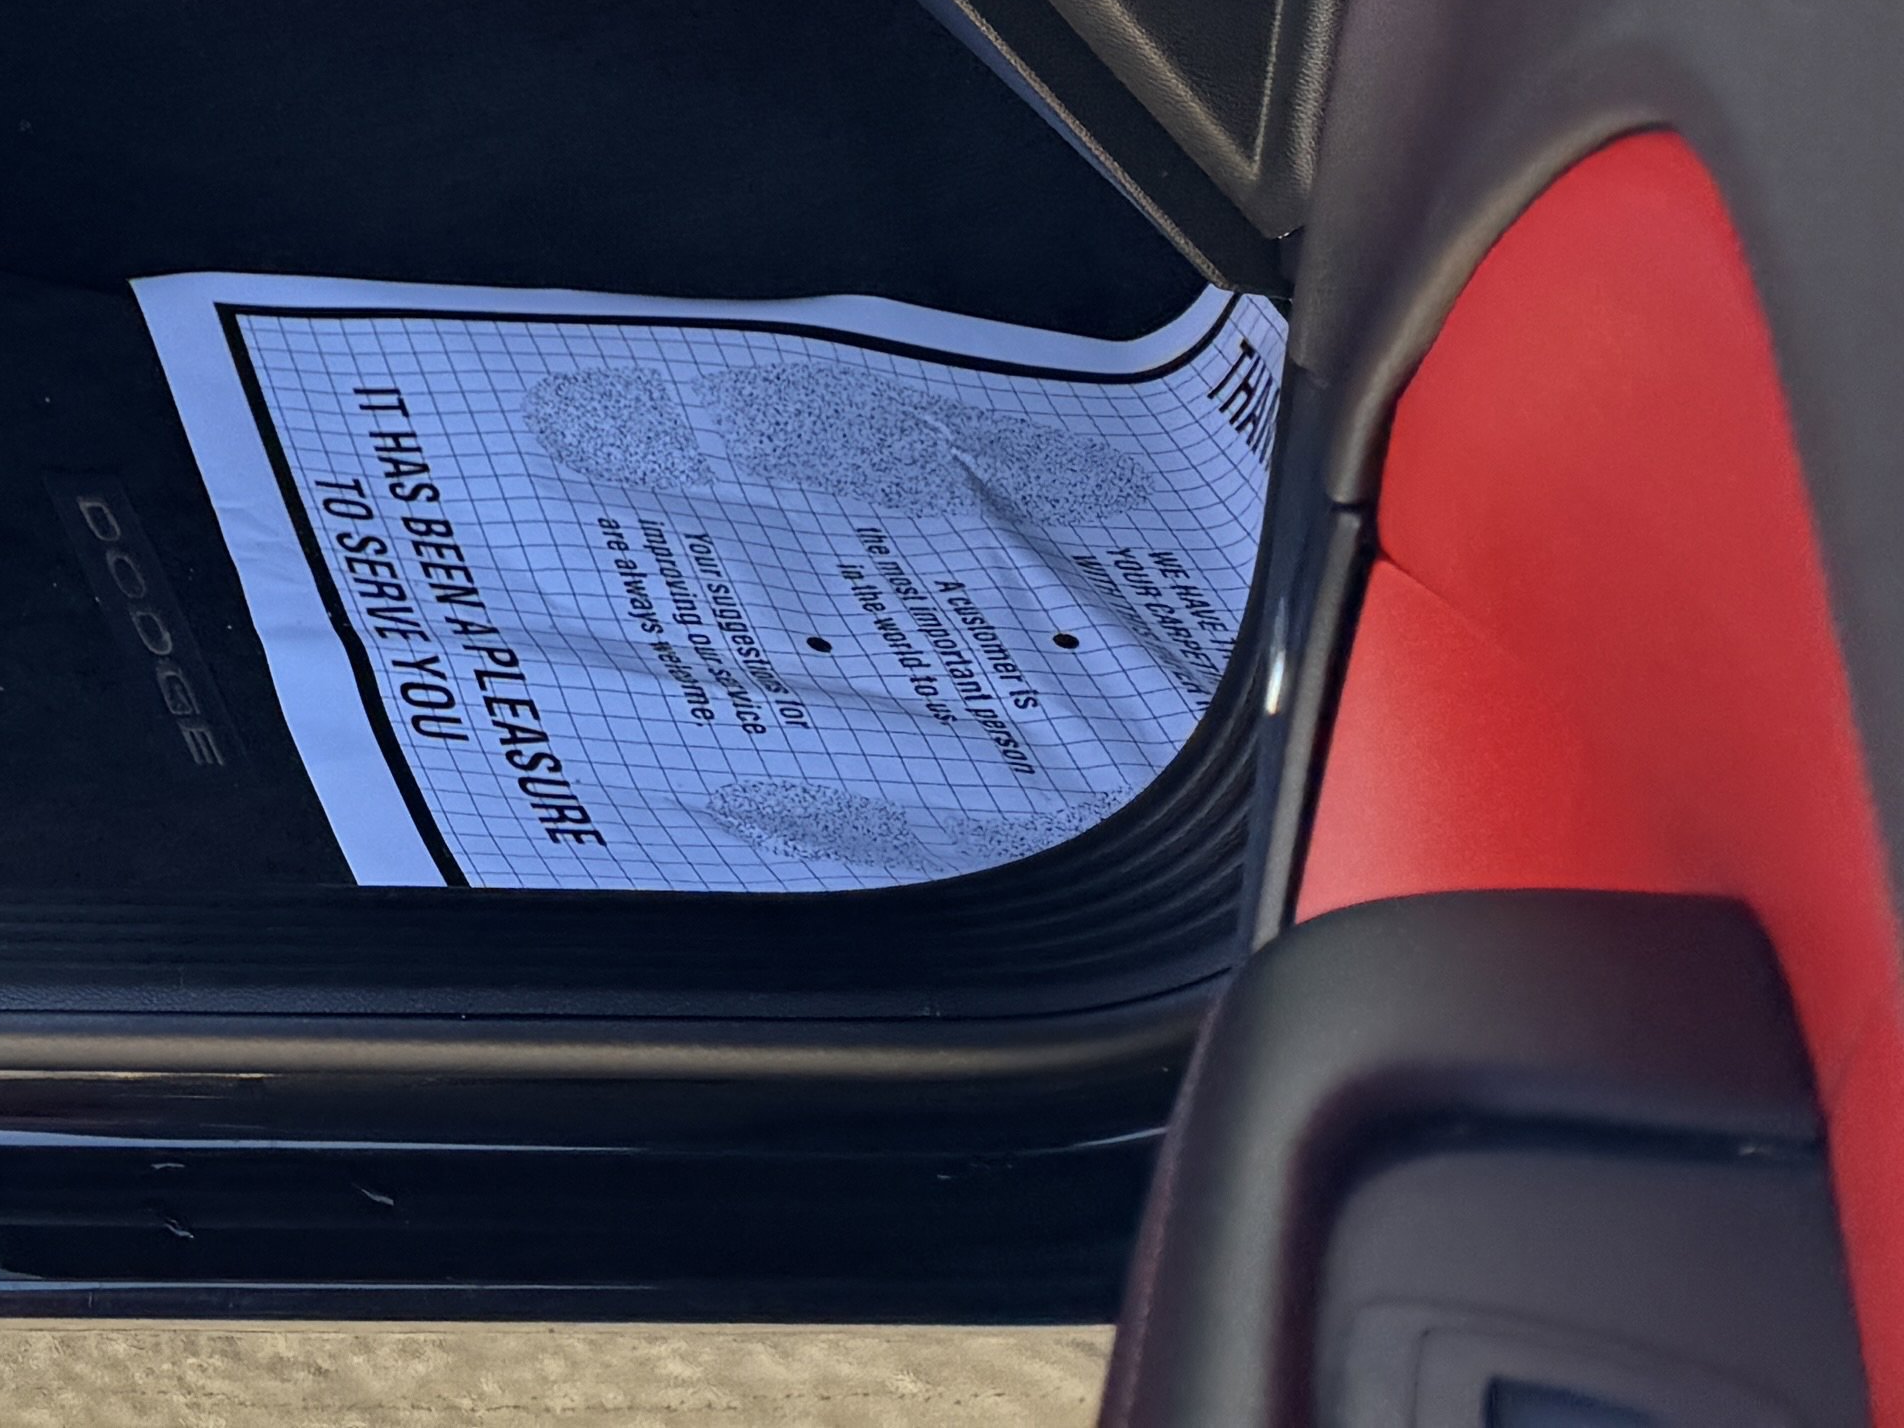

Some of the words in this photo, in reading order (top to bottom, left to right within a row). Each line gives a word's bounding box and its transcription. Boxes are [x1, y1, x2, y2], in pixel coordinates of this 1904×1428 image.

[353, 387, 410, 418] IT
[1207, 339, 1280, 472] THAN
[315, 479, 374, 520] TO
[369, 431, 441, 503] HAS
[337, 534, 431, 643] SERVE
[403, 516, 486, 610] BEEN
[597, 517, 630, 552] are
[614, 559, 664, 635] always
[934, 580, 965, 593] A
[1072, 555, 1126, 599] WITH
[1106, 547, 1163, 598] YOUR
[1148, 552, 1191, 580] WE
[1170, 584, 1229, 632] HAVE
[76, 495, 225, 766] DODGE
[445, 616, 501, 636] A
[638, 518, 704, 626] improving
[687, 633, 723, 665] our
[708, 667, 767, 735] service
[683, 532, 723, 578] Your
[775, 699, 810, 730] for
[837, 563, 865, 580] in
[851, 584, 886, 613] the
[874, 617, 932, 669] world
[910, 675, 939, 697] to
[856, 527, 891, 556] the
[877, 561, 927, 601] most
[909, 606, 992, 701] important
[965, 707, 1036, 775] person
[948, 597, 1024, 683] customer
[392, 655, 470, 742] YOU
[1009, 689, 1038, 710] is
[463, 643, 608, 847] PLEASURE
